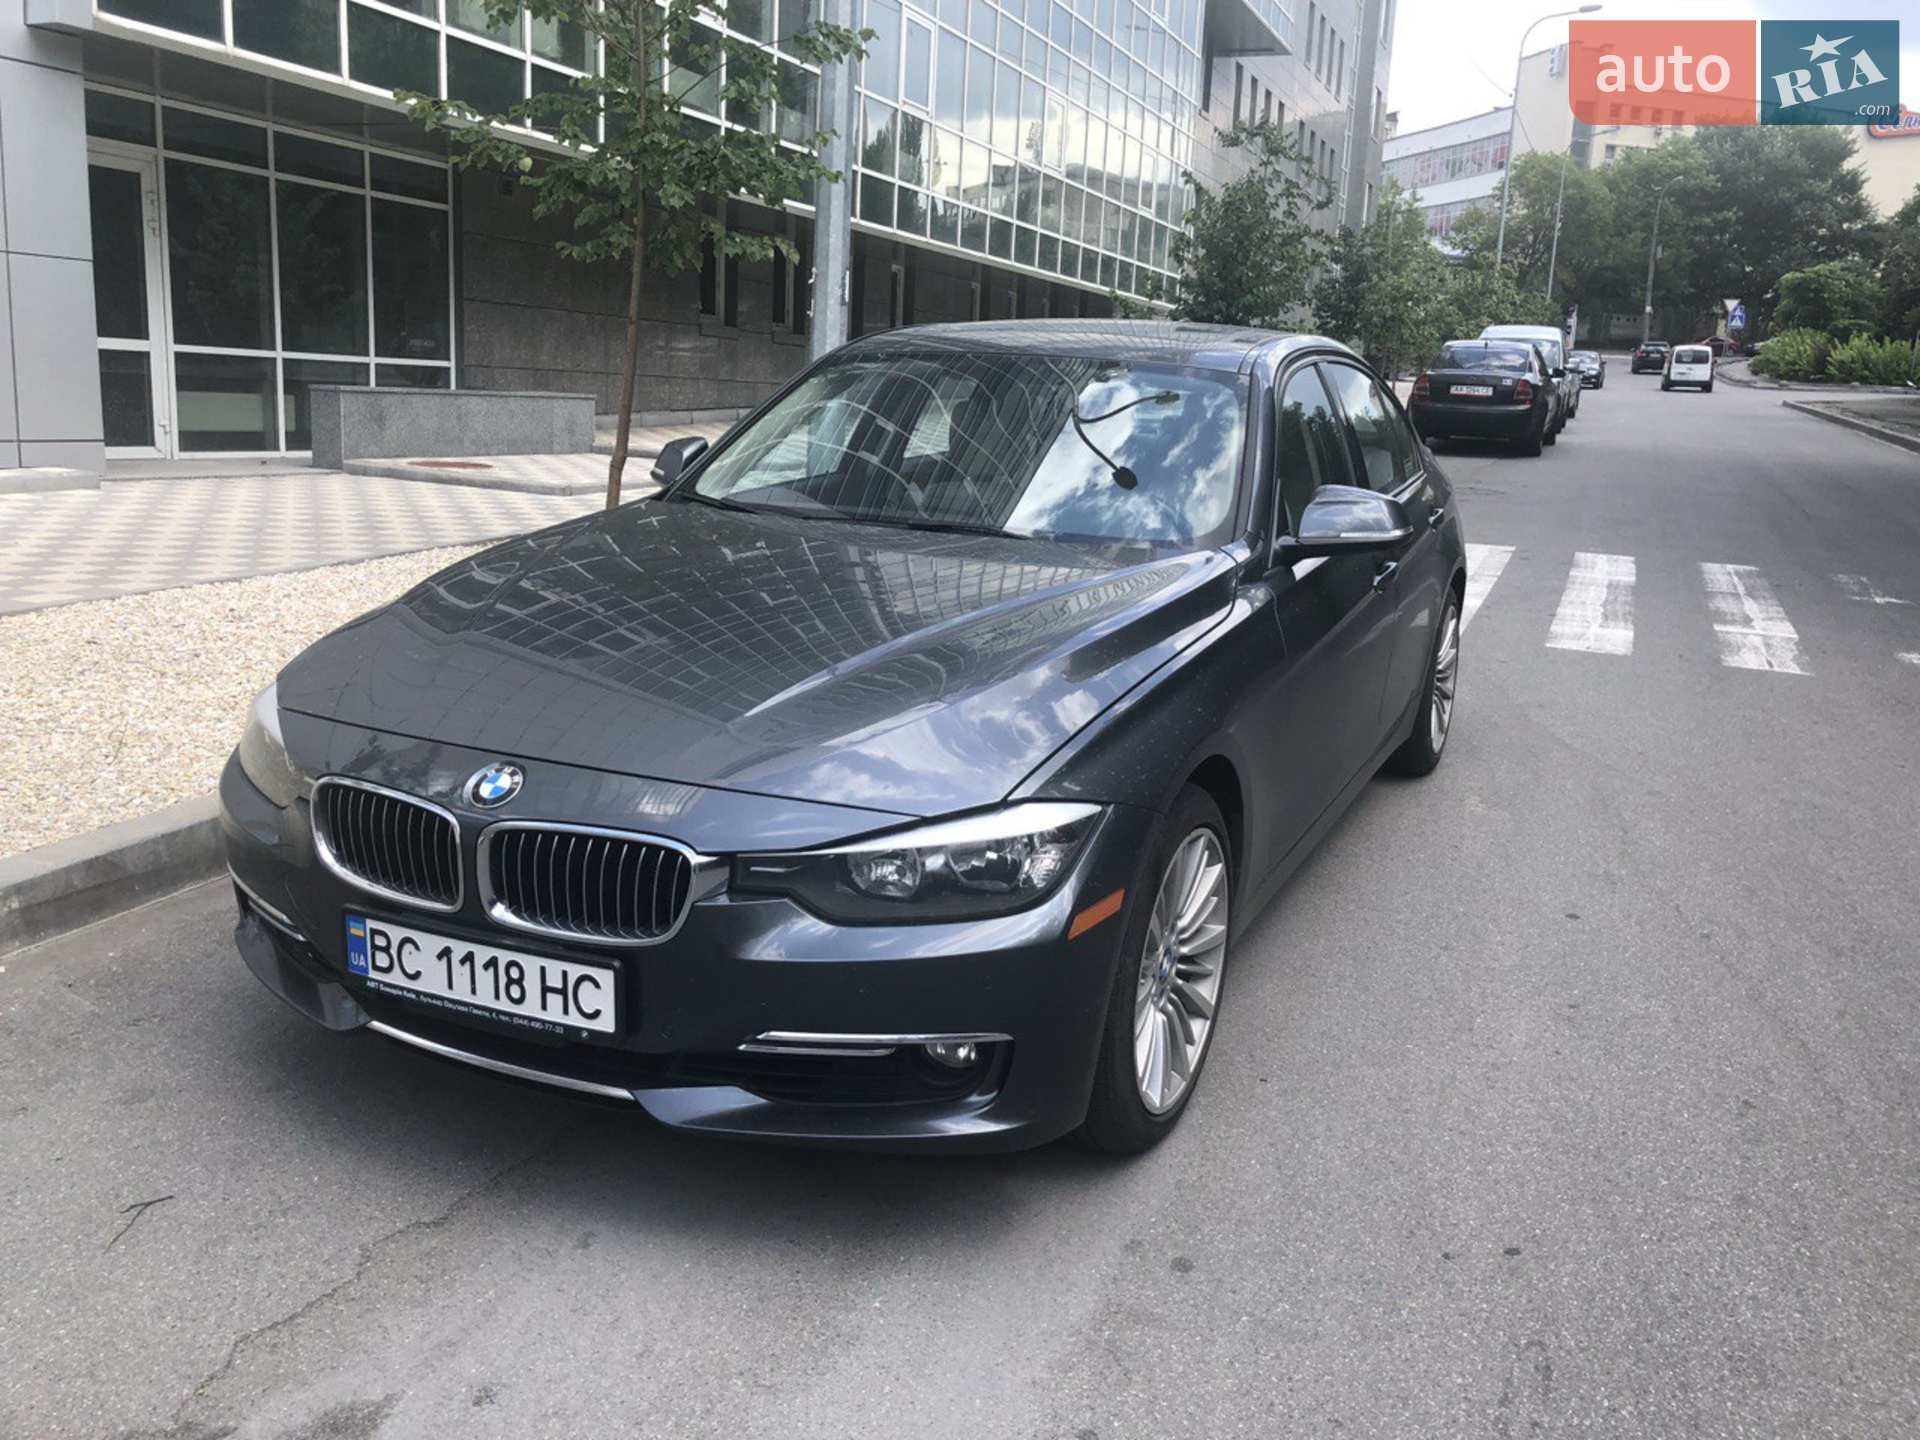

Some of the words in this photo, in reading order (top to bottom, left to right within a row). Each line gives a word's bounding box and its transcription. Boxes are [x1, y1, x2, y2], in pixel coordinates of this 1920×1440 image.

[350, 951, 367, 968] UA
[370, 927, 423, 981] BC
[436, 945, 526, 1005] 1118
[540, 965, 602, 1021] HC
[512, 1016, 529, 1027] (044)
